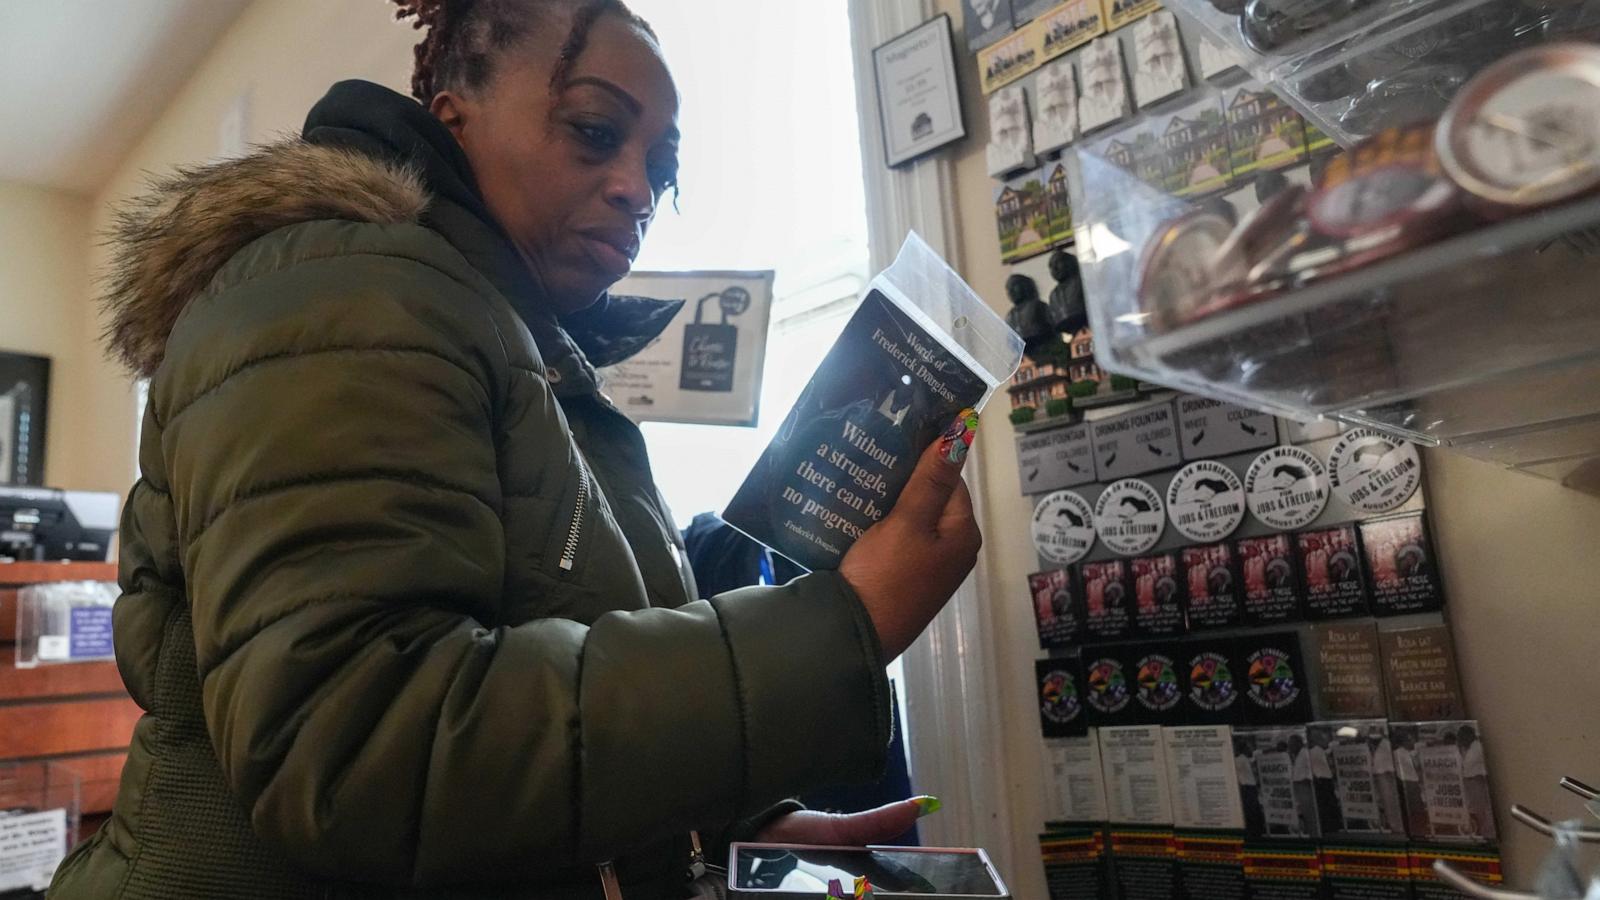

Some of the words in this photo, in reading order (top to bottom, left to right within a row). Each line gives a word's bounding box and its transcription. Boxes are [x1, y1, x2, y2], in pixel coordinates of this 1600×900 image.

[872, 328, 917, 371] Frederick
[916, 365, 956, 402] Douglass
[907, 332, 935, 363] Words
[934, 360, 947, 371] of
[1095, 419, 1130, 438] DRINKING
[1131, 409, 1168, 429] FOUNTAIN
[842, 420, 898, 470] Without
[1329, 457, 1340, 488] MARCH
[1337, 441, 1347, 453] ON
[1346, 428, 1405, 447] WASHINGTON
[796, 460, 836, 493] there
[836, 487, 865, 511] can
[864, 500, 882, 521] be
[816, 443, 829, 458] a
[828, 450, 888, 497] struggle,
[1170, 476, 1183, 505] MARCH
[1183, 468, 1194, 478] ON
[1196, 462, 1241, 492] WASHINGTON
[1247, 464, 1261, 493] MARCH
[1261, 455, 1272, 465] ON
[1274, 449, 1324, 477] WASHINGTON
[1349, 488, 1370, 505] JOBS
[1376, 457, 1416, 488] FREEDOM
[781, 486, 803, 505] no
[800, 498, 865, 540] progress
[1178, 513, 1196, 526] JOBS
[1204, 502, 1240, 521] FREEDOM
[1256, 501, 1276, 514] JOBS
[1285, 488, 1323, 509] FREEDOM
[1262, 763, 1289, 773] MARCH
[1337, 756, 1367, 766] MARCH
[1424, 758, 1457, 768] MARCH
[1348, 781, 1371, 792] JOBS
[1435, 783, 1460, 795] JOBS
